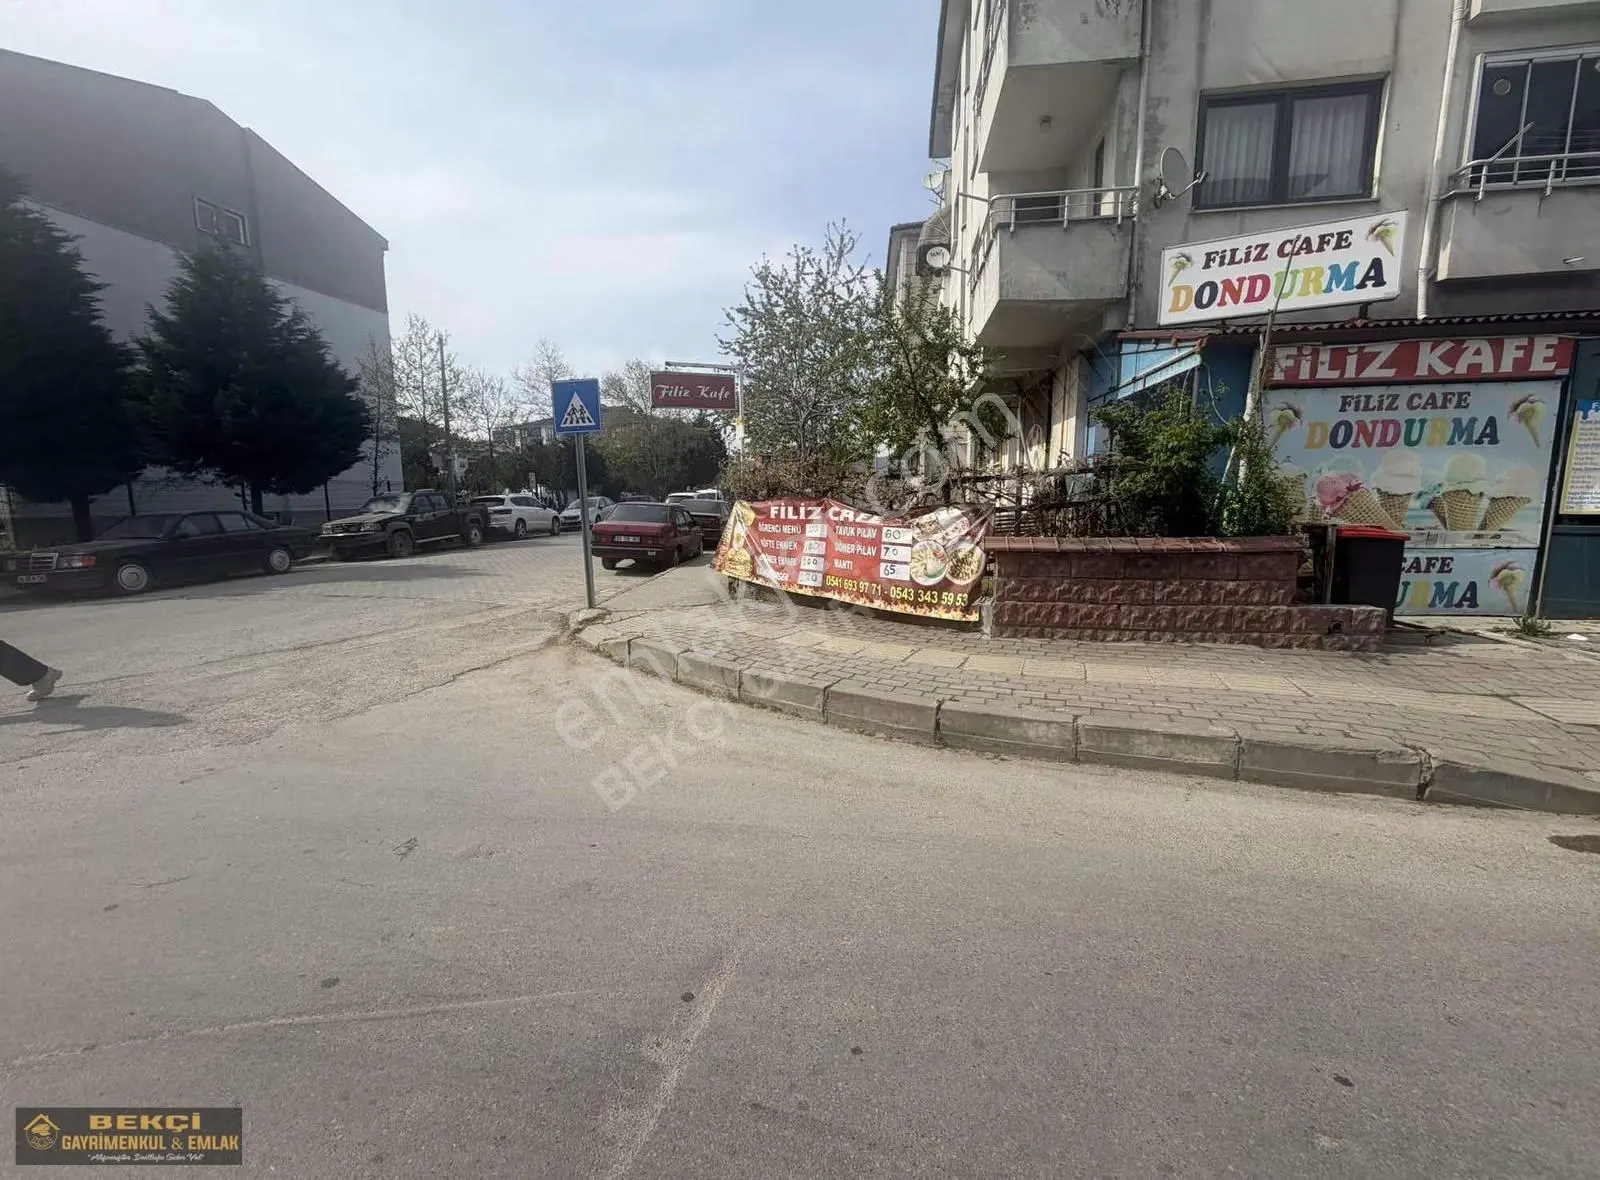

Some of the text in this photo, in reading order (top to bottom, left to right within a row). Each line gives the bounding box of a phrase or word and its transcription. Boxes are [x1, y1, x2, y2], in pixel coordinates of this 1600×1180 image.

[1277, 230, 1354, 259] CAFE
[1168, 256, 1387, 313] DONDURMA
[1415, 336, 1560, 376] KAFE
[653, 384, 691, 400] Filiz
[1406, 391, 1472, 410] CAFE
[1304, 415, 1500, 449] DONDURMA
[828, 506, 885, 524] CAFE
[883, 564, 897, 576] 65
[826, 575, 843, 588] 0541
[859, 582, 869, 593] 97
[871, 583, 882, 595] 71
[890, 586, 915, 602] 0543
[917, 590, 939, 604] 343
[941, 592, 955, 605] 59
[955, 593, 969, 606] 53
